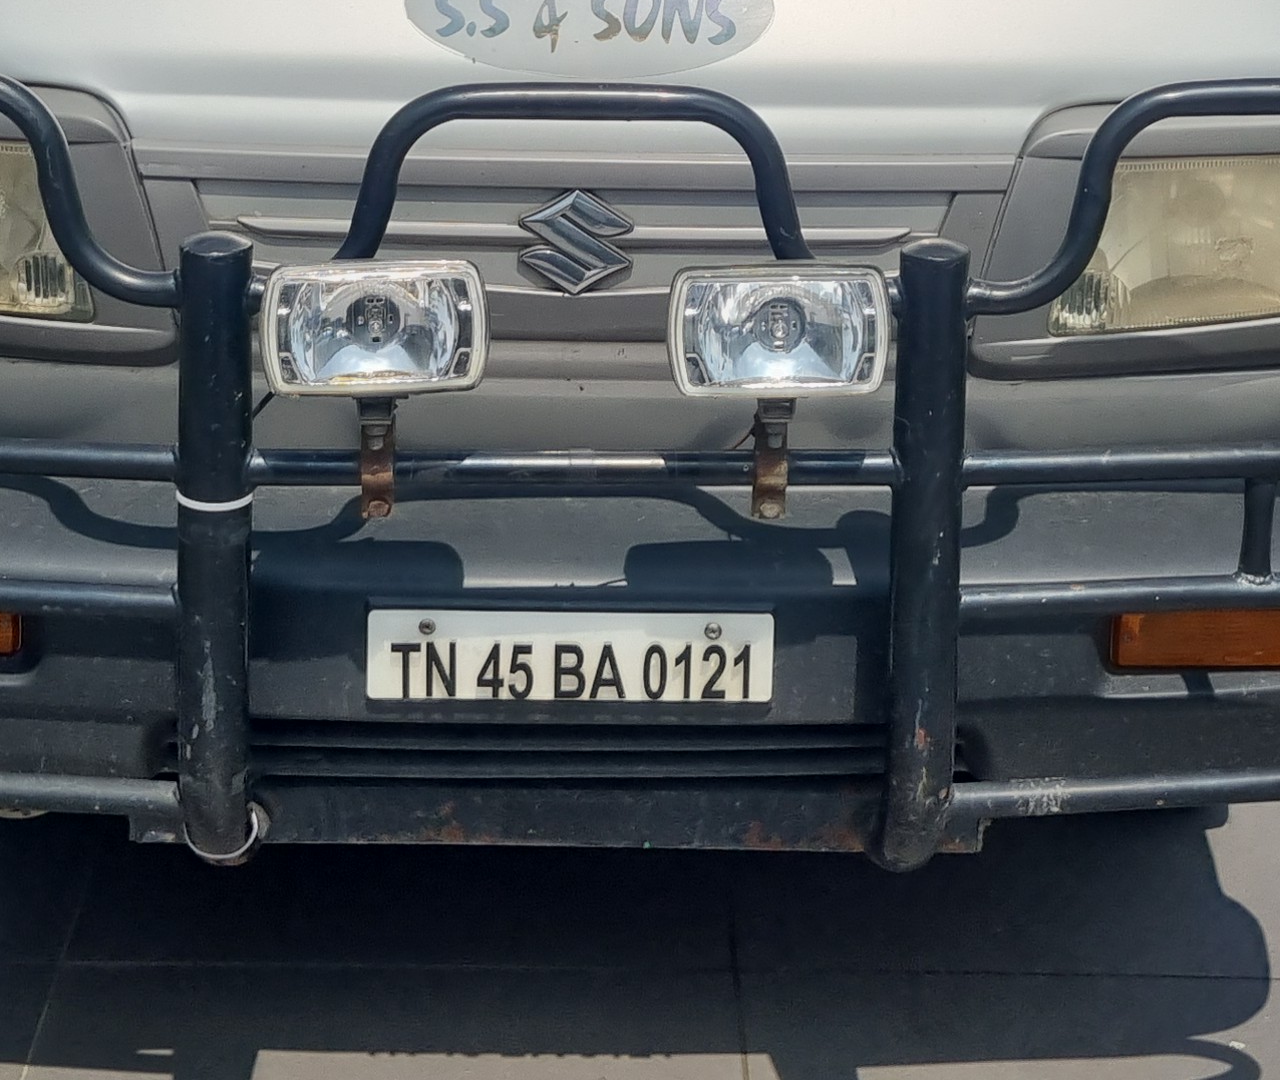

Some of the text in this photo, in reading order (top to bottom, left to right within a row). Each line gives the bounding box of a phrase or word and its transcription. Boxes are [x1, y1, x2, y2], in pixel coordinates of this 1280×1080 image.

[390, 641, 752, 701] TN 45 BA 0121
